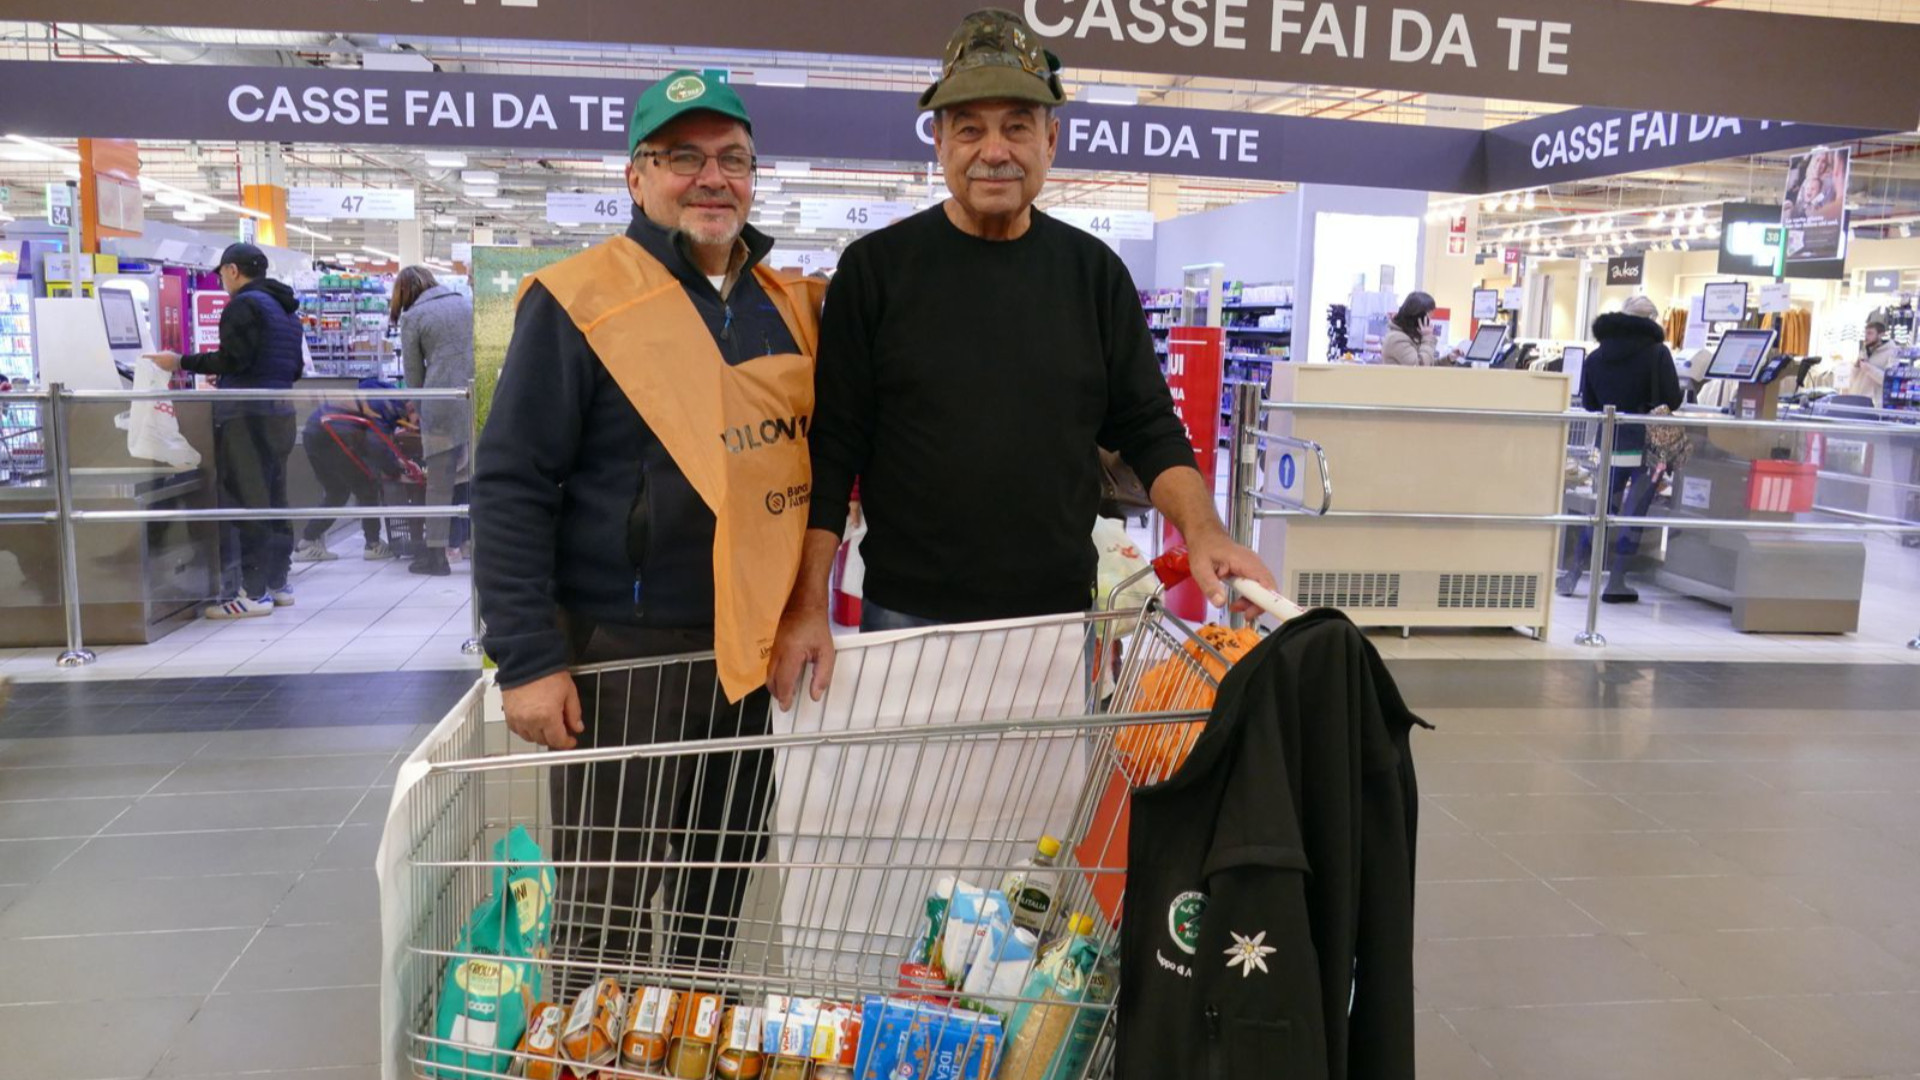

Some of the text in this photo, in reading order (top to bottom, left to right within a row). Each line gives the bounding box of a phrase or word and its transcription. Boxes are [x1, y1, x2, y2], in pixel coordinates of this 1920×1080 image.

[1024, 0, 1572, 76] CASSE FAI DA TE
[228, 84, 625, 132] CASSE FAI DA TE
[1068, 118, 1260, 163] FAI DA TE
[1530, 117, 1621, 169] CASSE
[1627, 110, 1679, 153] FAI
[341, 195, 364, 213] 47
[594, 199, 618, 216] 46
[53, 206, 69, 224] 34
[846, 207, 868, 224] 45
[1090, 216, 1112, 232] 44
[797, 254, 811, 265] 45
[1170, 353, 1184, 376] UI
